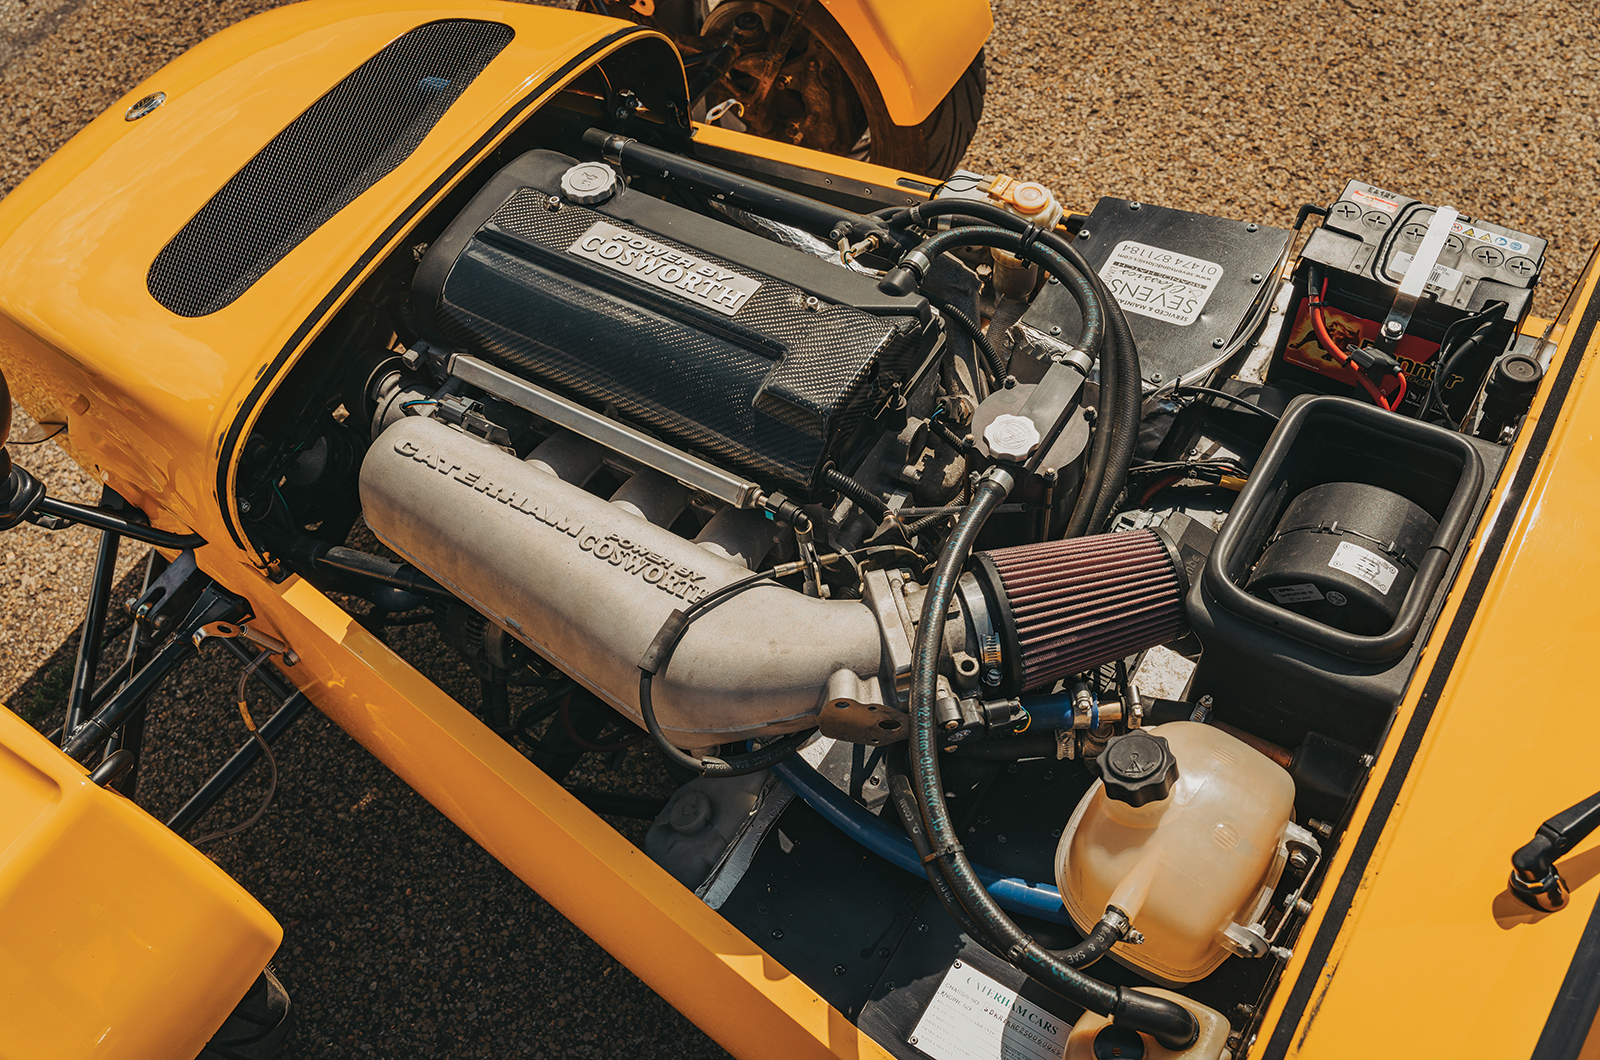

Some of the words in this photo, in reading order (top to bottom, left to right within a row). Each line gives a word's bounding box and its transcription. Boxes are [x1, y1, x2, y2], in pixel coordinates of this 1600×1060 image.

[612, 233, 696, 269] POWER
[697, 266, 734, 282] BY
[1122, 244, 1172, 263] 871184
[1174, 258, 1217, 275] 01474
[581, 235, 745, 310] COSWORTH
[1117, 253, 1212, 281] www.sevensandclassics.com
[1119, 269, 1186, 293] Classics
[1111, 279, 1198, 314] SEVENS
[1117, 298, 1147, 311] MAINTAI
[1154, 309, 1189, 322] SERVICED
[393, 438, 587, 539] CATERHAM
[578, 534, 711, 605] COSWORTH
[604, 533, 675, 570] POWER
[675, 565, 707, 583] BY
[1067, 949, 1087, 965] SAE
[940, 991, 961, 1006] ENGINE
[945, 982, 969, 1001] CHASSIS
[967, 976, 1026, 1017] CATERHAM
[1029, 1012, 1059, 1036] CARS
